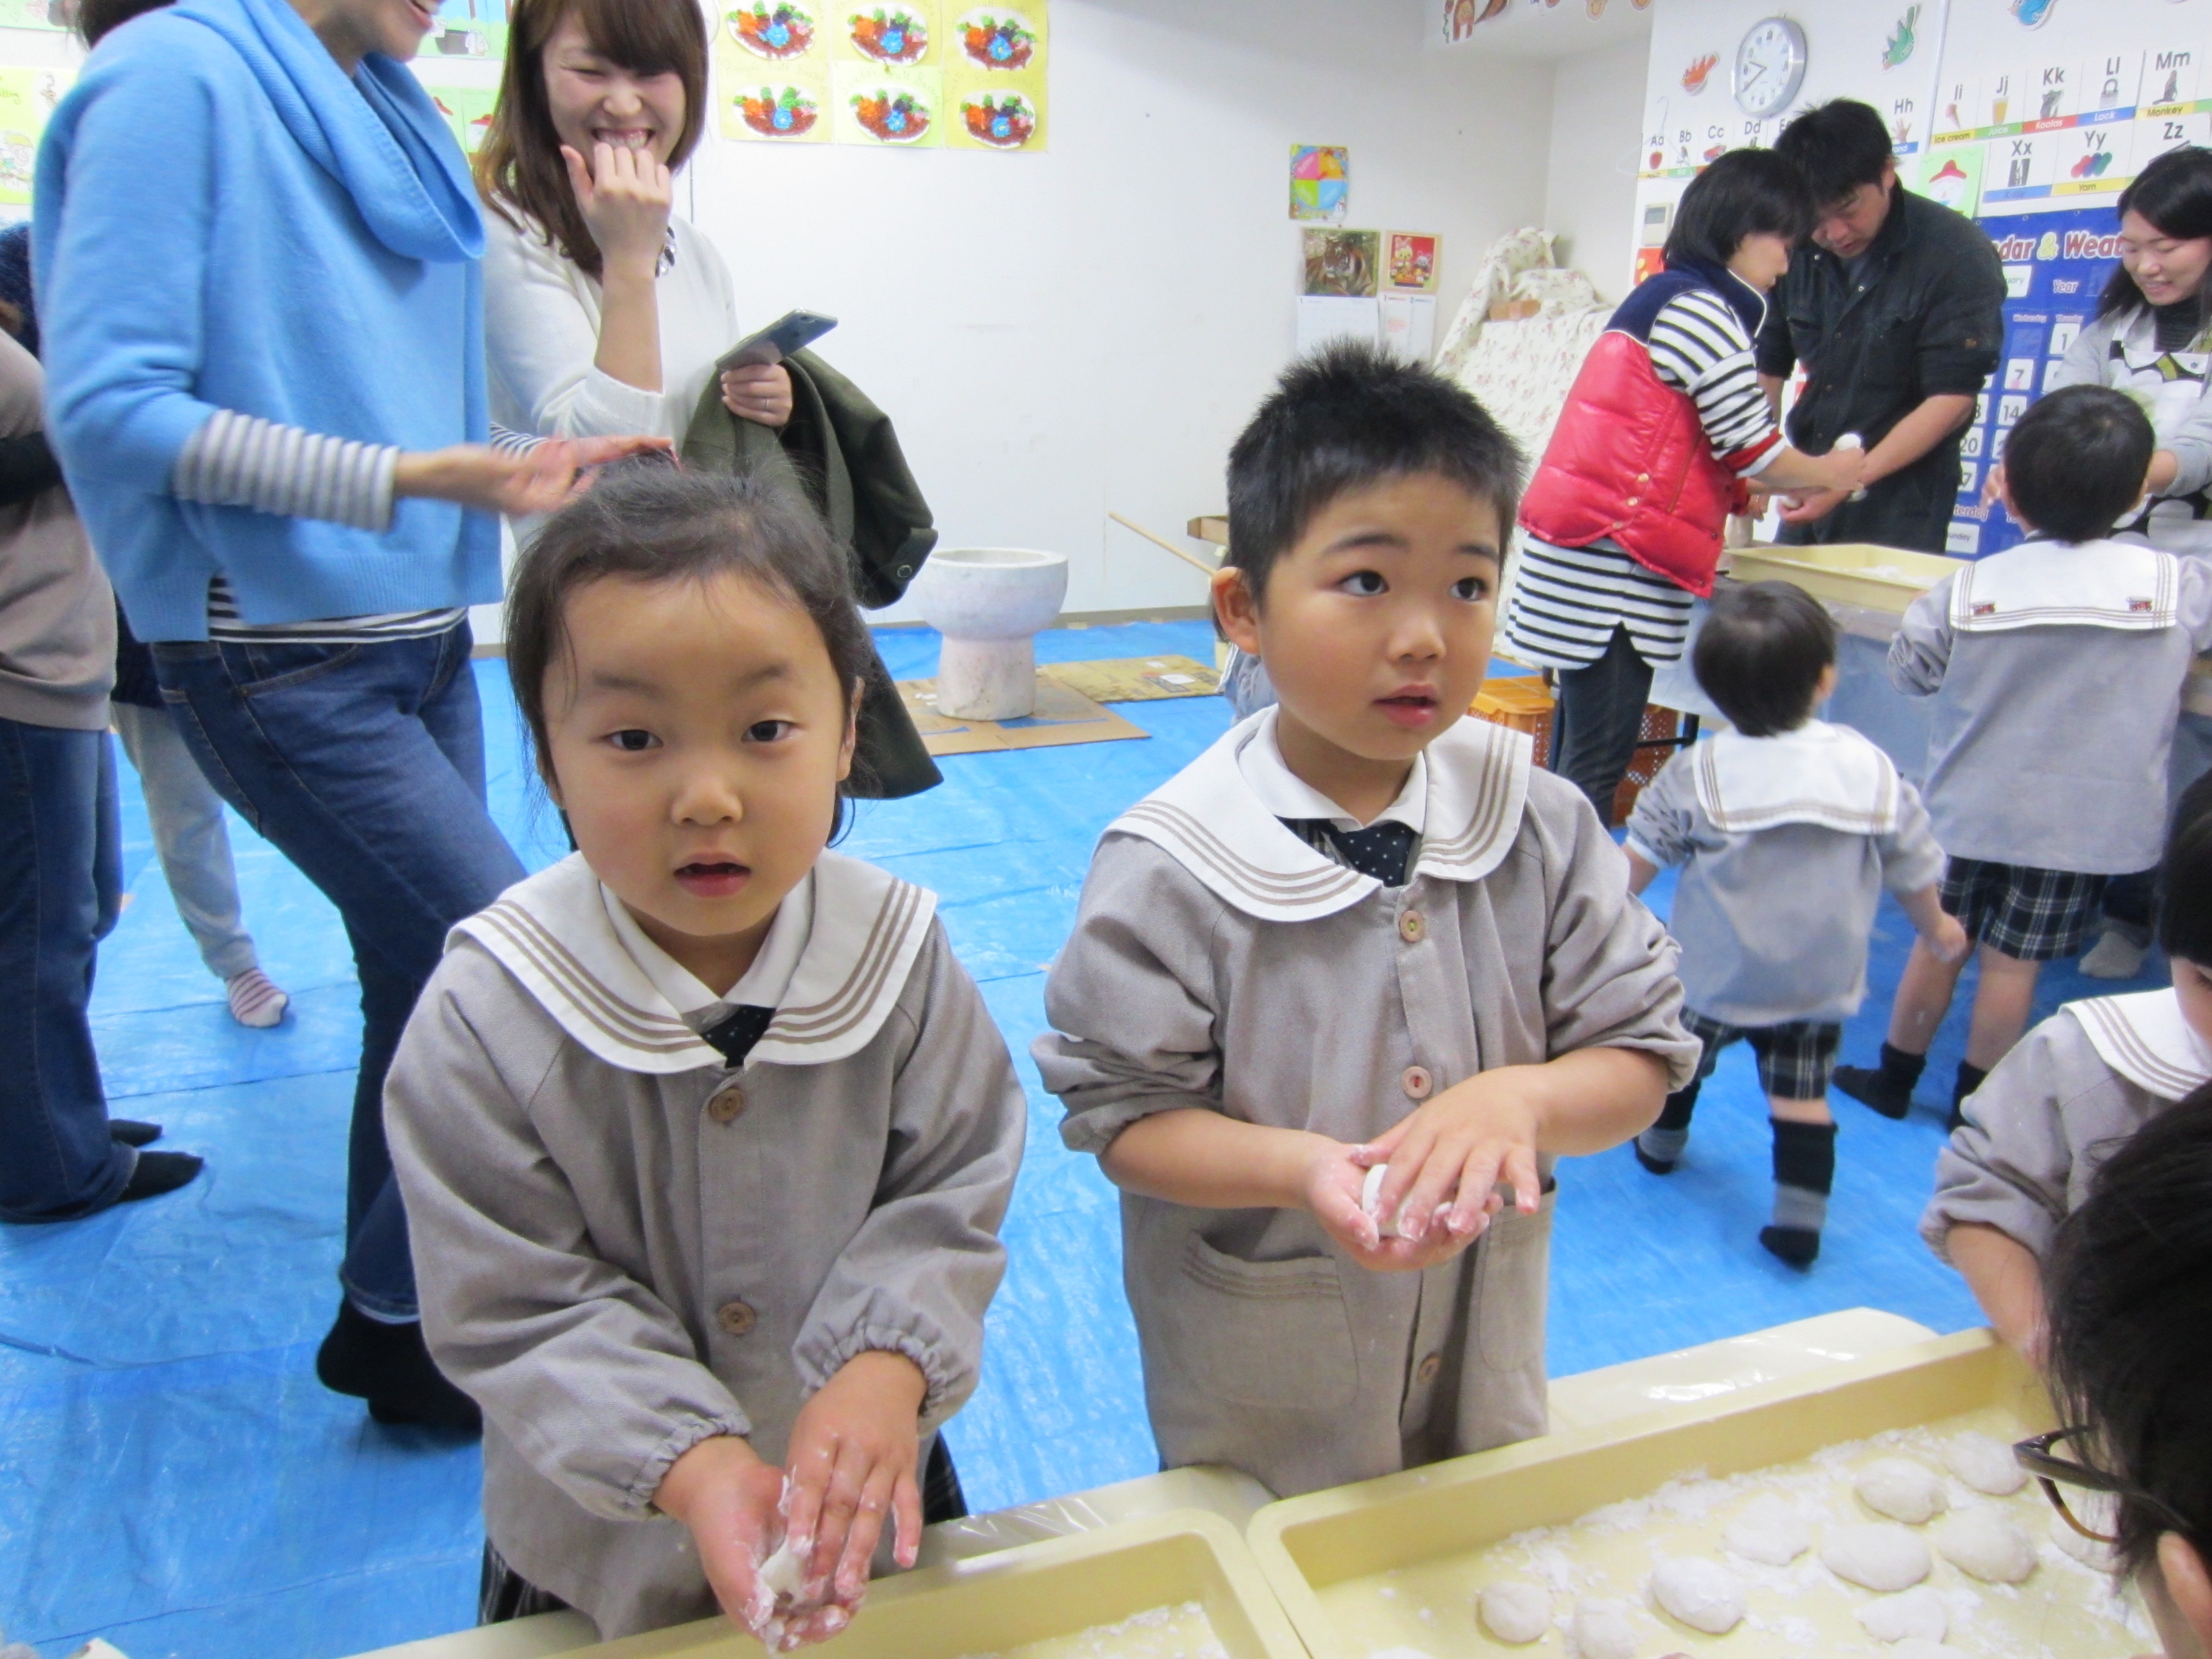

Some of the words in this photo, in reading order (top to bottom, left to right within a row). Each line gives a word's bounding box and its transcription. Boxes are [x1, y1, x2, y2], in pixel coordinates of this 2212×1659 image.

[2106, 56, 2121, 75] Ll
[2156, 51, 2190, 71] Mm
[2043, 67, 2065, 86] Kk
[1954, 84, 1963, 101] Ii
[1996, 76, 2008, 96] Jj
[1895, 98, 1913, 114] Hh
[2147, 106, 2183, 118] Monkey
[2094, 111, 2116, 121] Lock
[1744, 119, 1761, 134] Dd
[1988, 126, 2008, 136] Juice
[2036, 119, 2063, 129] Koalas
[2163, 122, 2183, 140] Zz
[1679, 130, 1692, 143] Bb
[1708, 126, 1724, 139] Cc
[1947, 133, 1970, 142] cream
[1650, 134, 1664, 147] Aa
[2011, 139, 2032, 157] Xx
[2084, 130, 2107, 151] Yy
[2079, 183, 2096, 191] Yarn
[2037, 232, 2059, 260] &
[2053, 279, 2078, 293] Year
[2062, 333, 2067, 351] 1
[2015, 369, 2025, 380] 7
